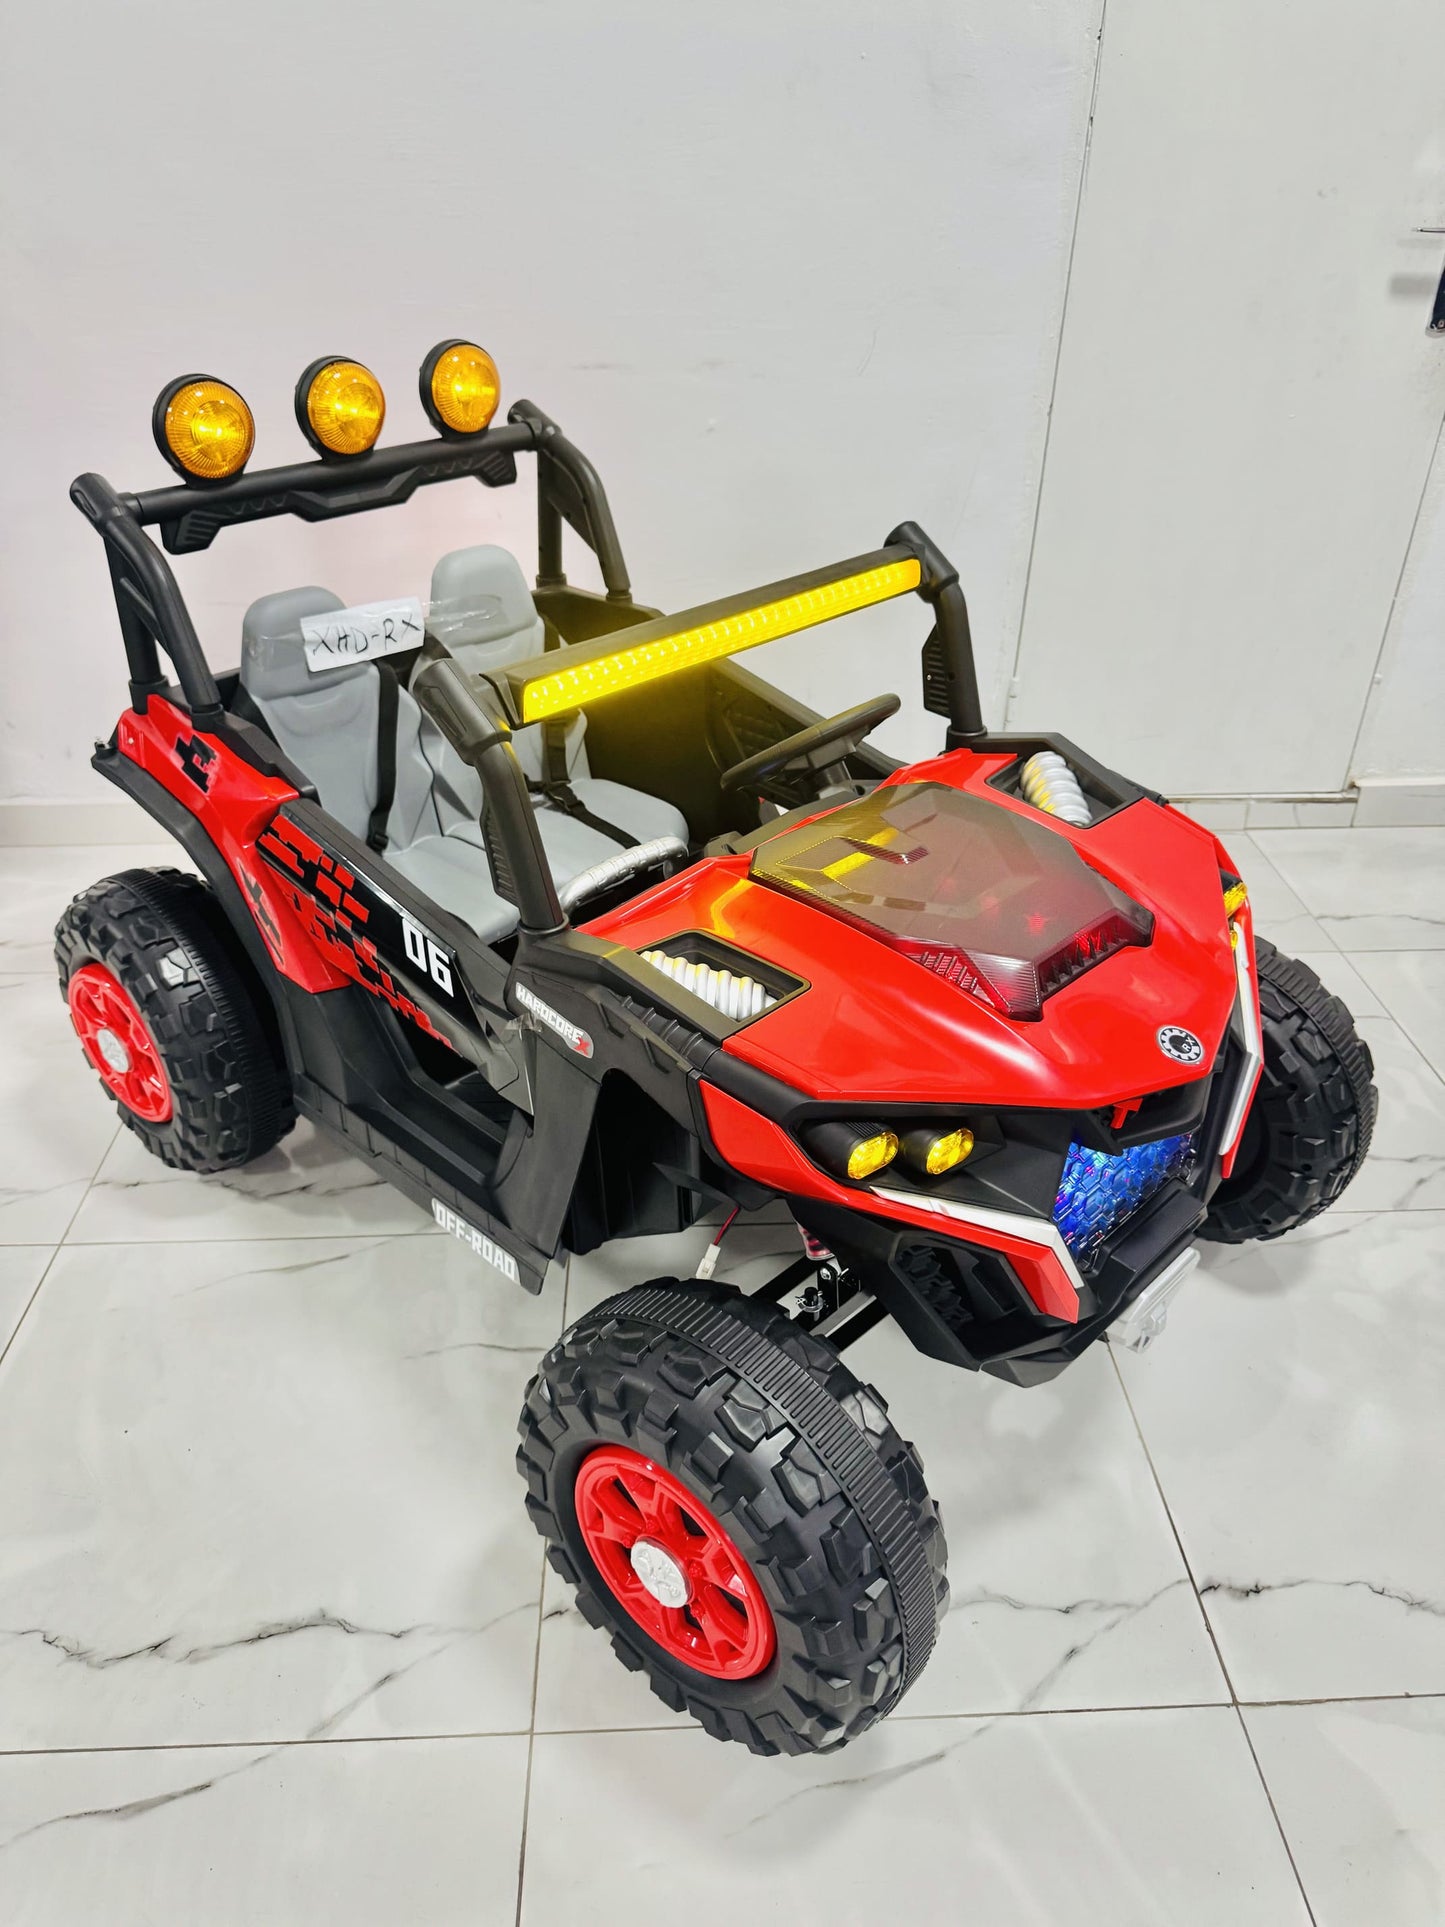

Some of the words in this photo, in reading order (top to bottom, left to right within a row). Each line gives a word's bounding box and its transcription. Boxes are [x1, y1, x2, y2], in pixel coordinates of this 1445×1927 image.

[312, 613, 421, 656] XHD-RX
[402, 918, 454, 997] 06
[435, 1201, 515, 1280] OFF-ROAD
